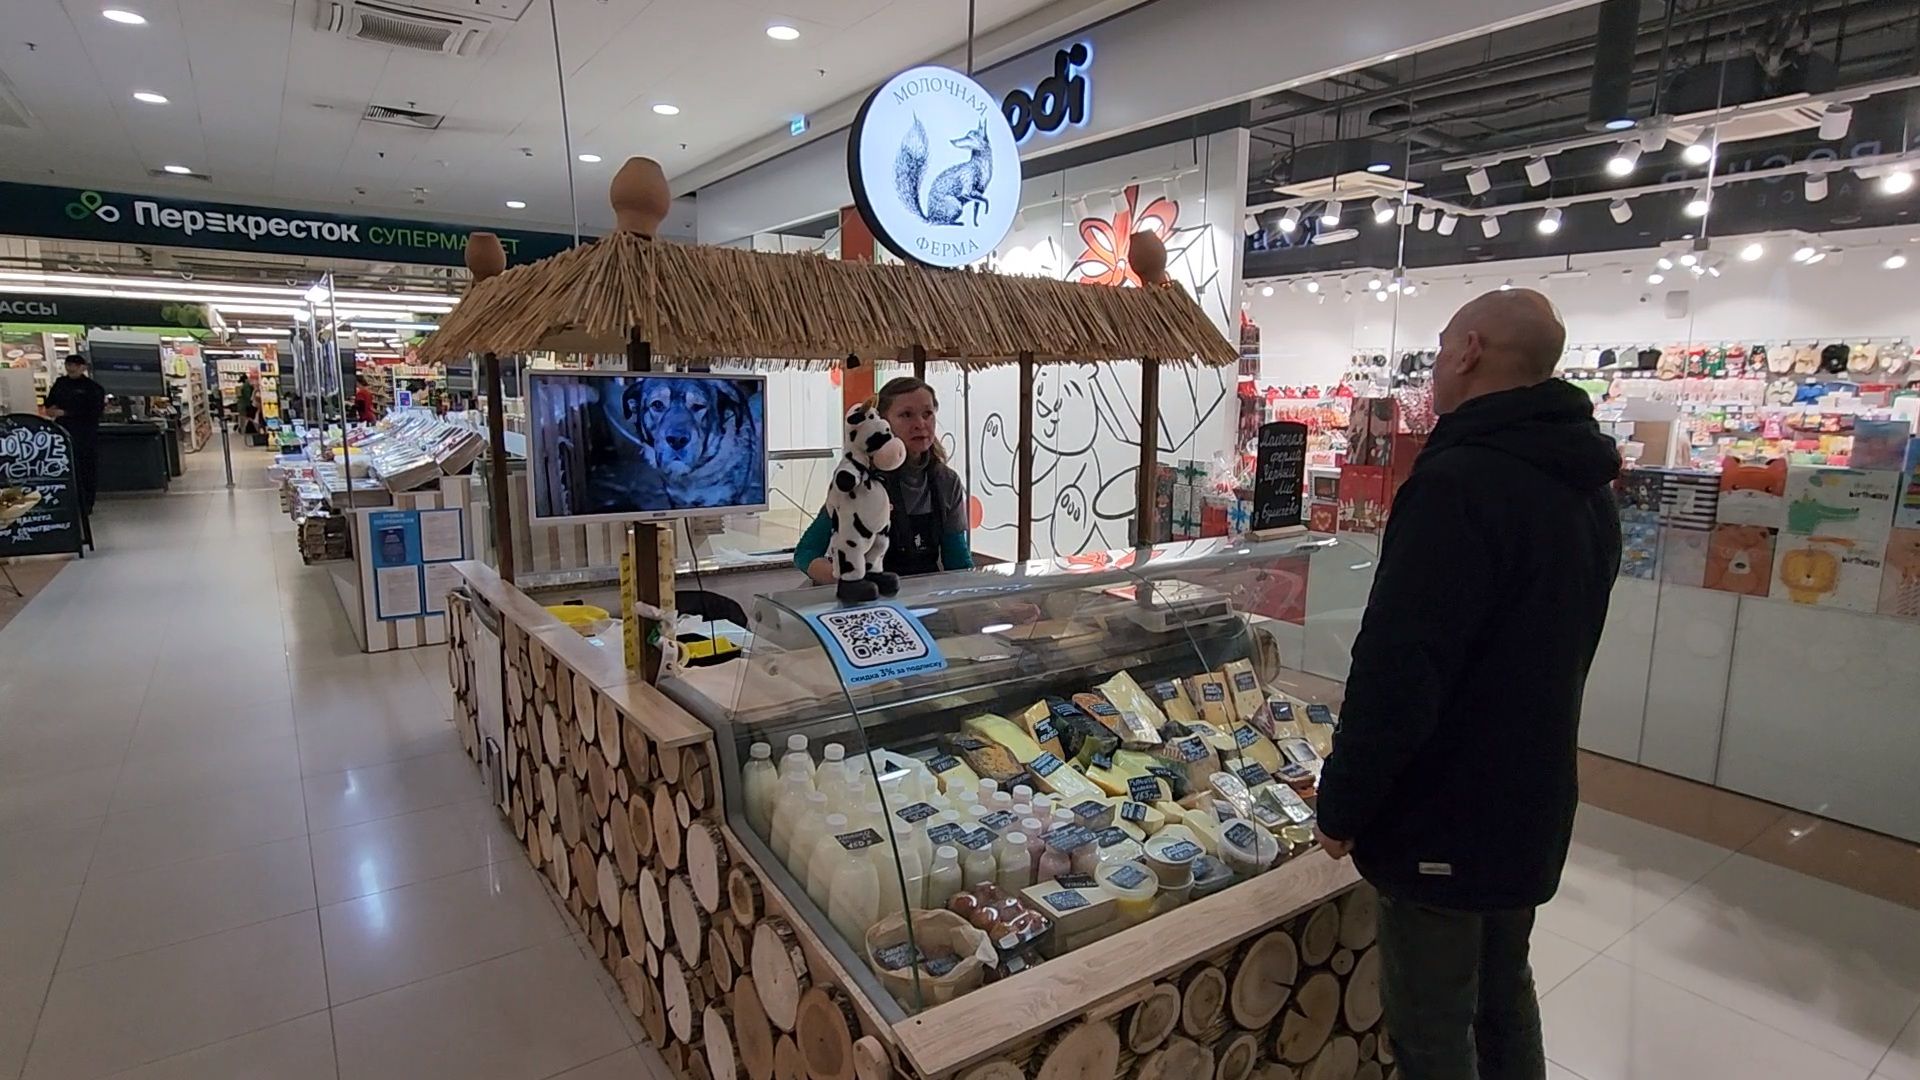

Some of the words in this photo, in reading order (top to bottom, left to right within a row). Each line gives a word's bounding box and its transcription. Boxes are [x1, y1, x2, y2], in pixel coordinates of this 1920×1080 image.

[893, 77, 988, 116] МОЛОЧНАЯ
[1002, 43, 1088, 143] odi
[134, 201, 360, 243] Перекресток
[368, 226, 520, 255] СУПЕРМАЕТ
[916, 236, 979, 257] ФЕРМА
[0, 300, 58, 316] АССЫ
[850, 673, 879, 682] скидка
[880, 667, 895, 677] 3%
[906, 661, 942, 672] подписку
